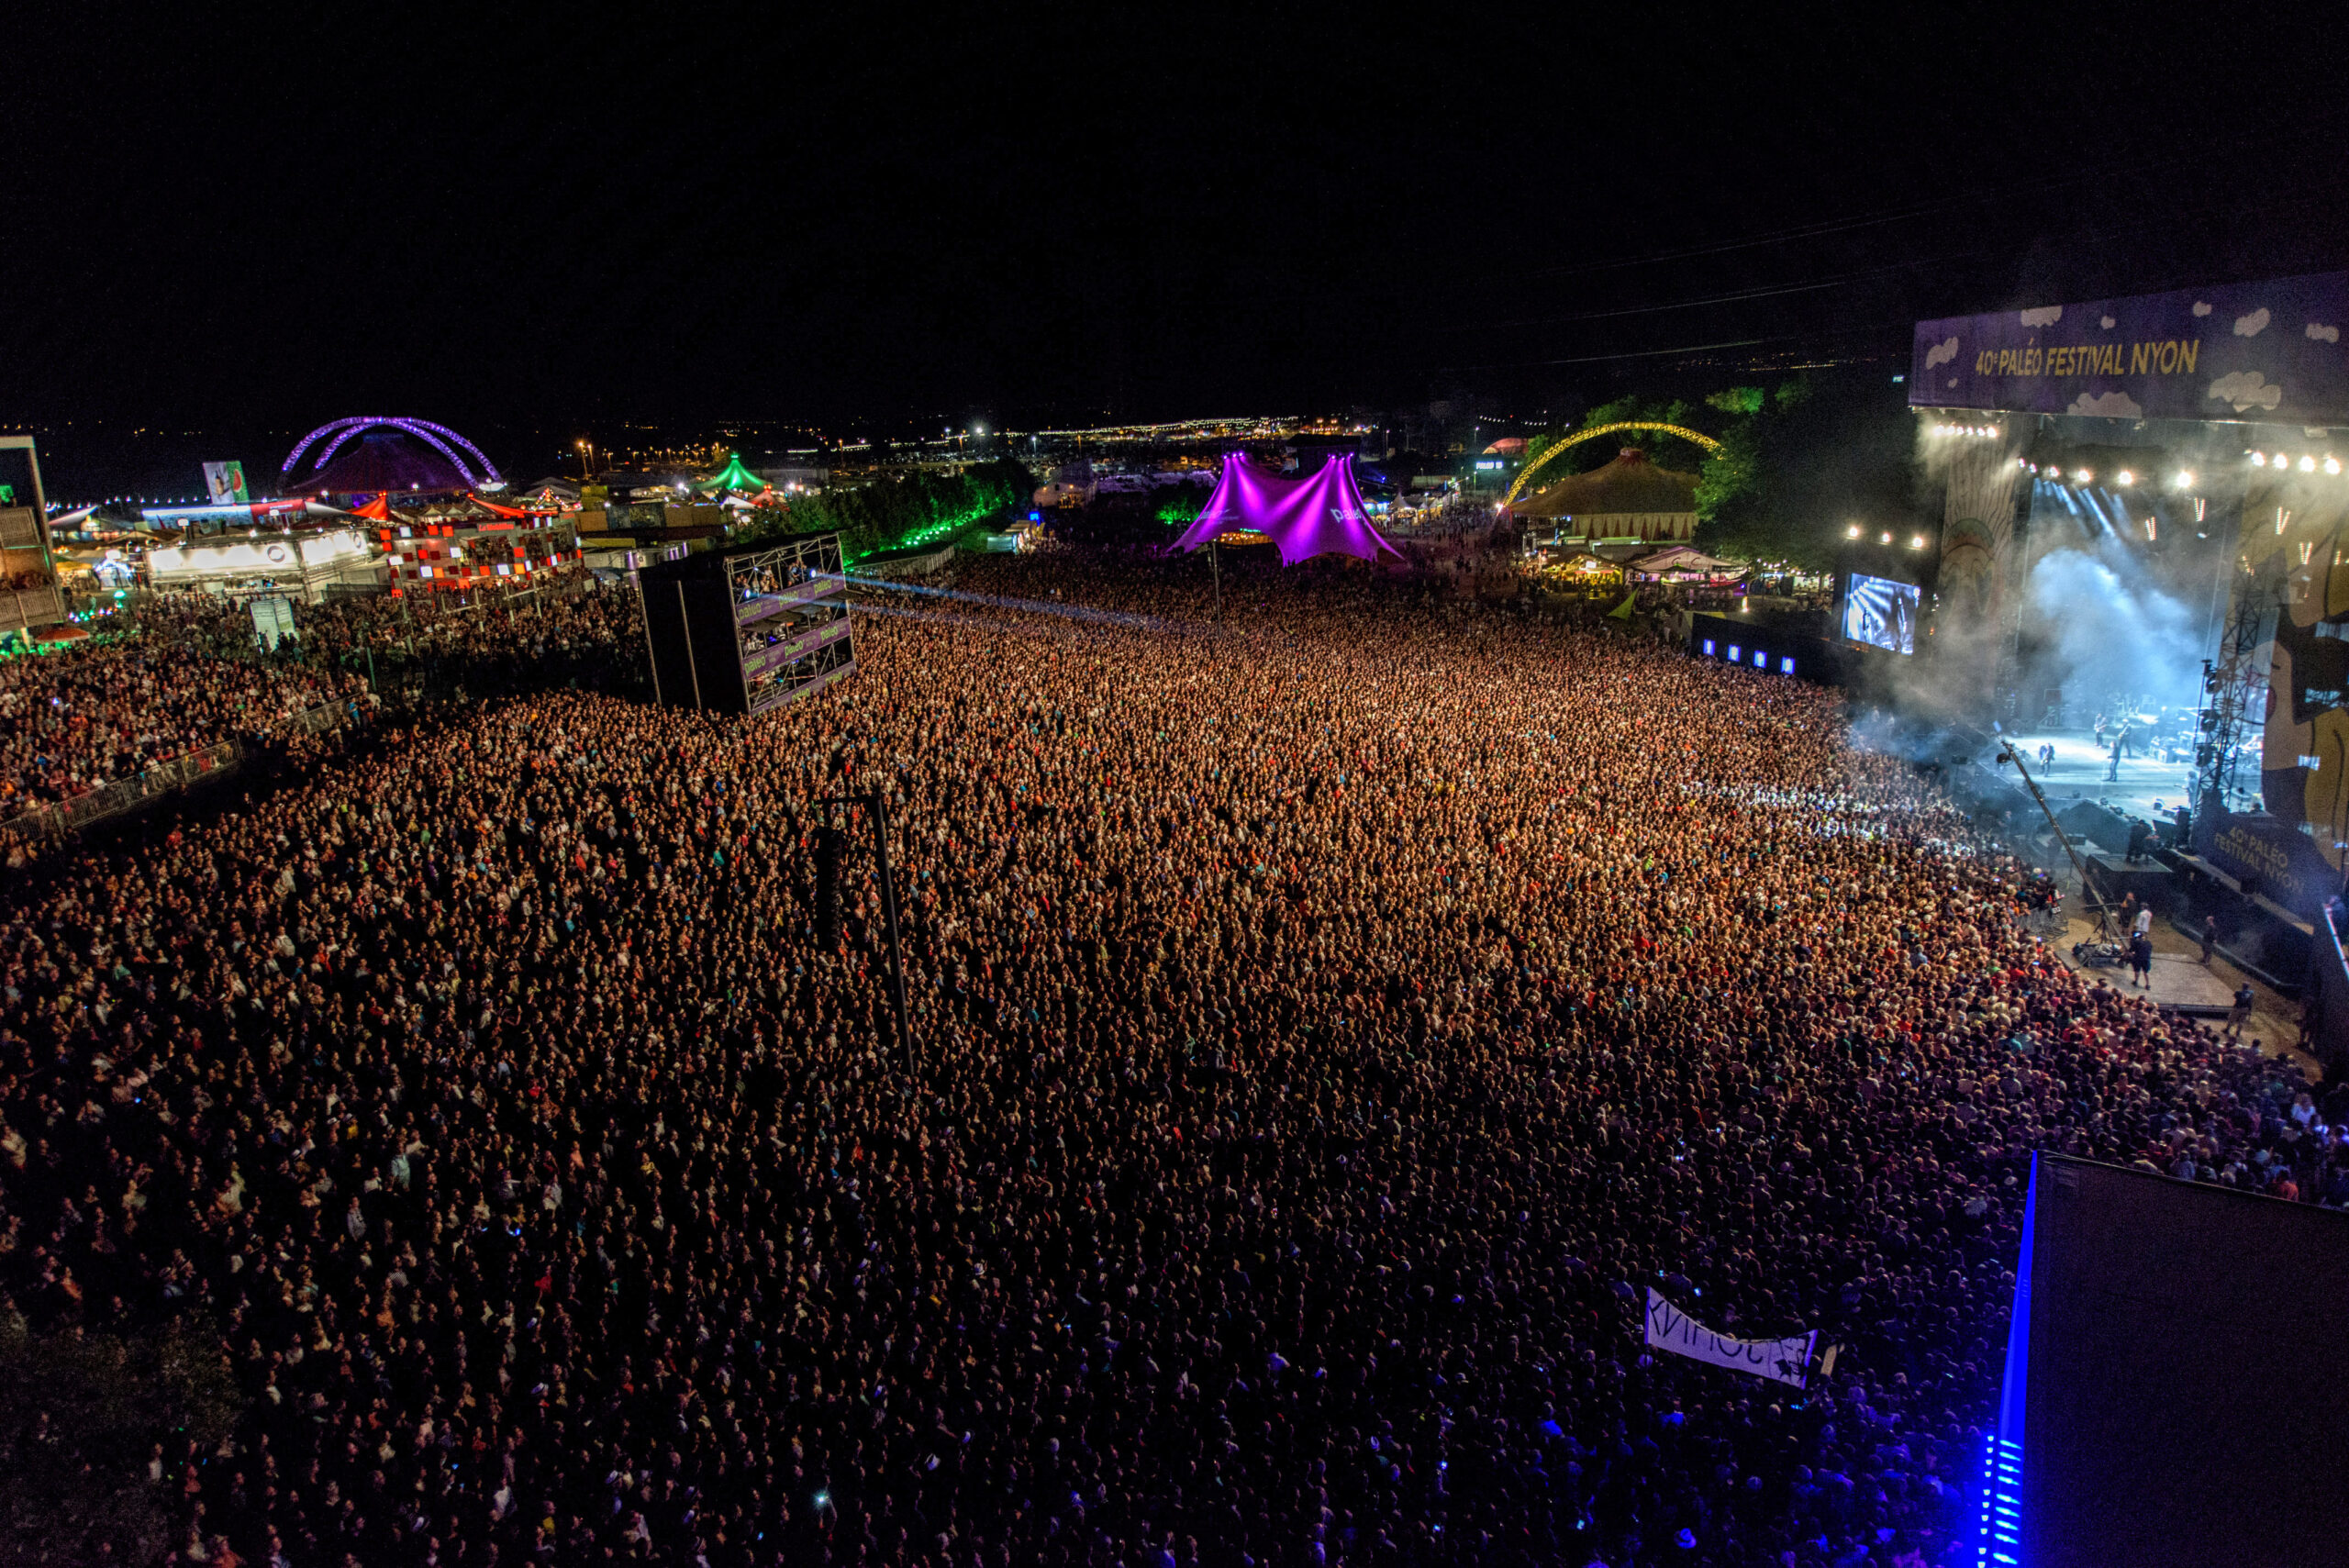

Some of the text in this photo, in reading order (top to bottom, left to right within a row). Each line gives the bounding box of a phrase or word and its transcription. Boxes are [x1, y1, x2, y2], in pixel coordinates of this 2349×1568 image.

[1998, 337, 2043, 376] PALÉO
[2045, 344, 2125, 376] FESTIVAL
[2130, 339, 2200, 375] NYON
[2214, 832, 2304, 895] FESTIVAL NYON
[2249, 835, 2288, 869] PALÉO
